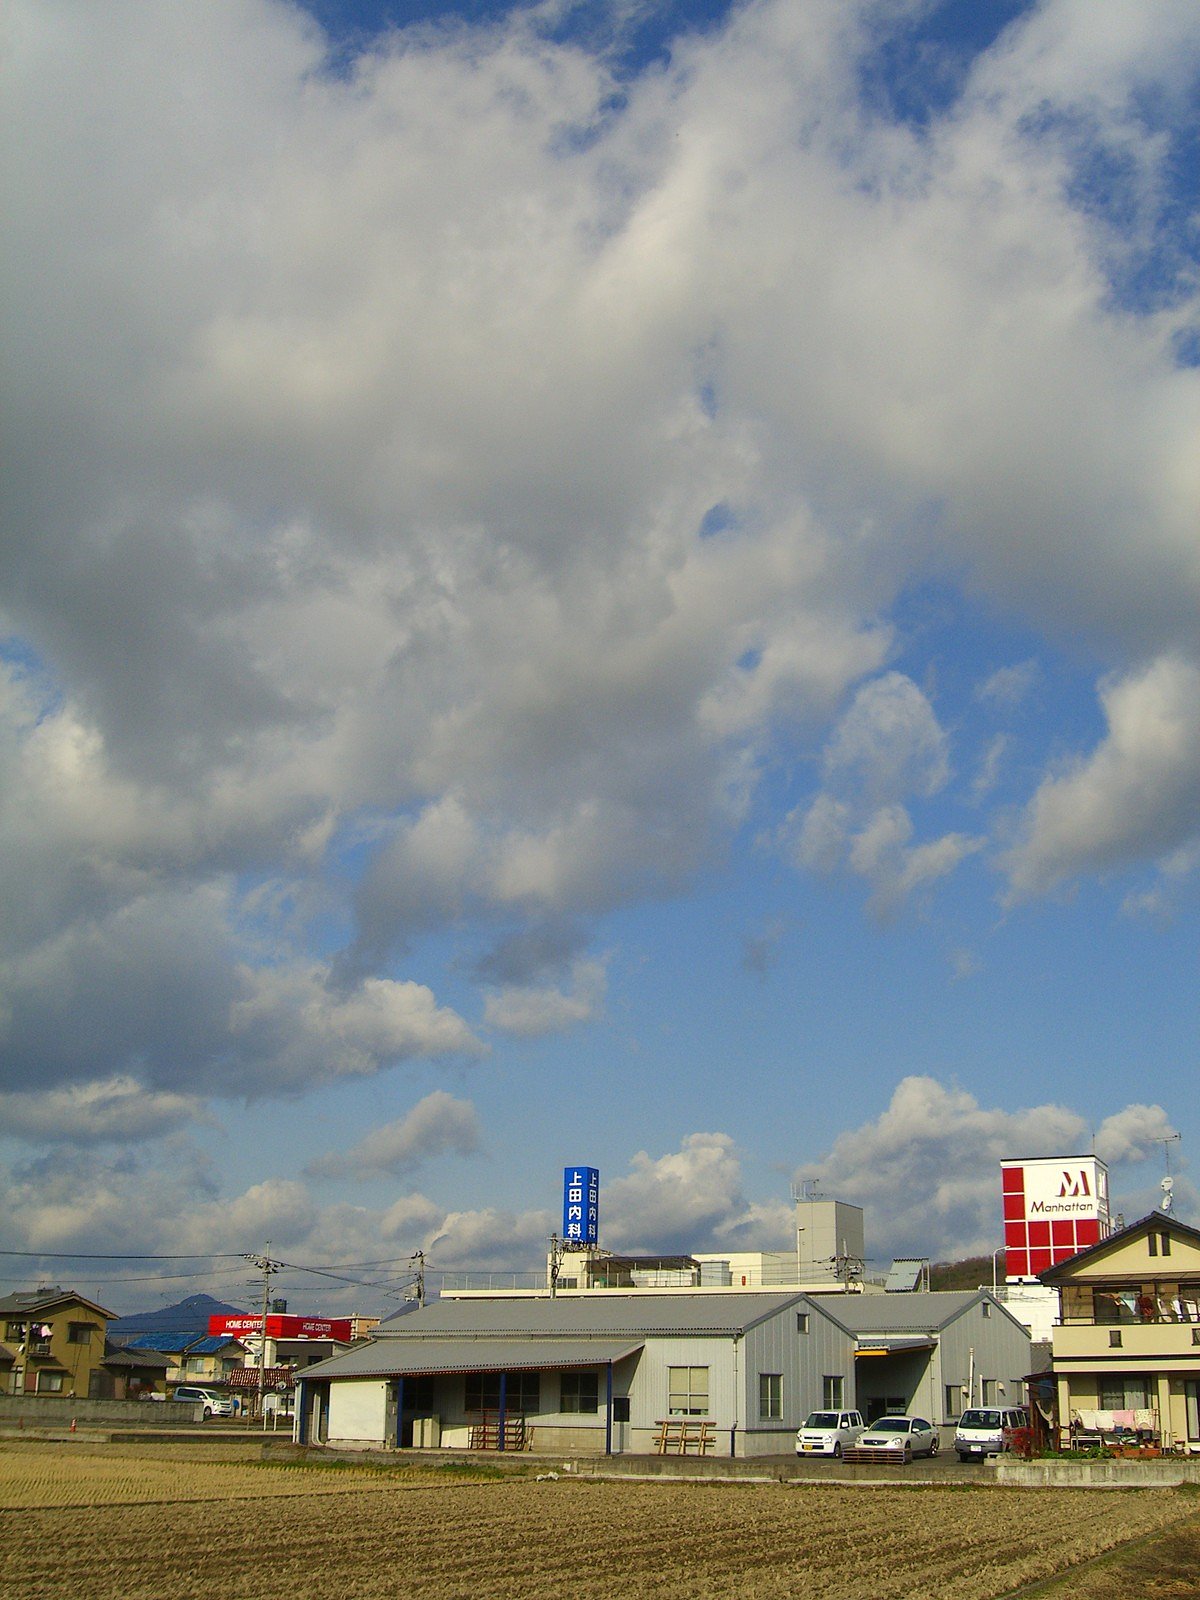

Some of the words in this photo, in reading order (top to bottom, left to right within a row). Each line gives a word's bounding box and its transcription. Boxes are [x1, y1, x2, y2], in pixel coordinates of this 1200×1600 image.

[568, 1171, 582, 1238] 上田内科
[589, 1172, 597, 1239] 上田内科
[1030, 1200, 1093, 1213] Manhattan
[225, 1320, 242, 1329] HOME
[302, 1322, 315, 1331] HOME
[315, 1323, 331, 1332] CENTER
